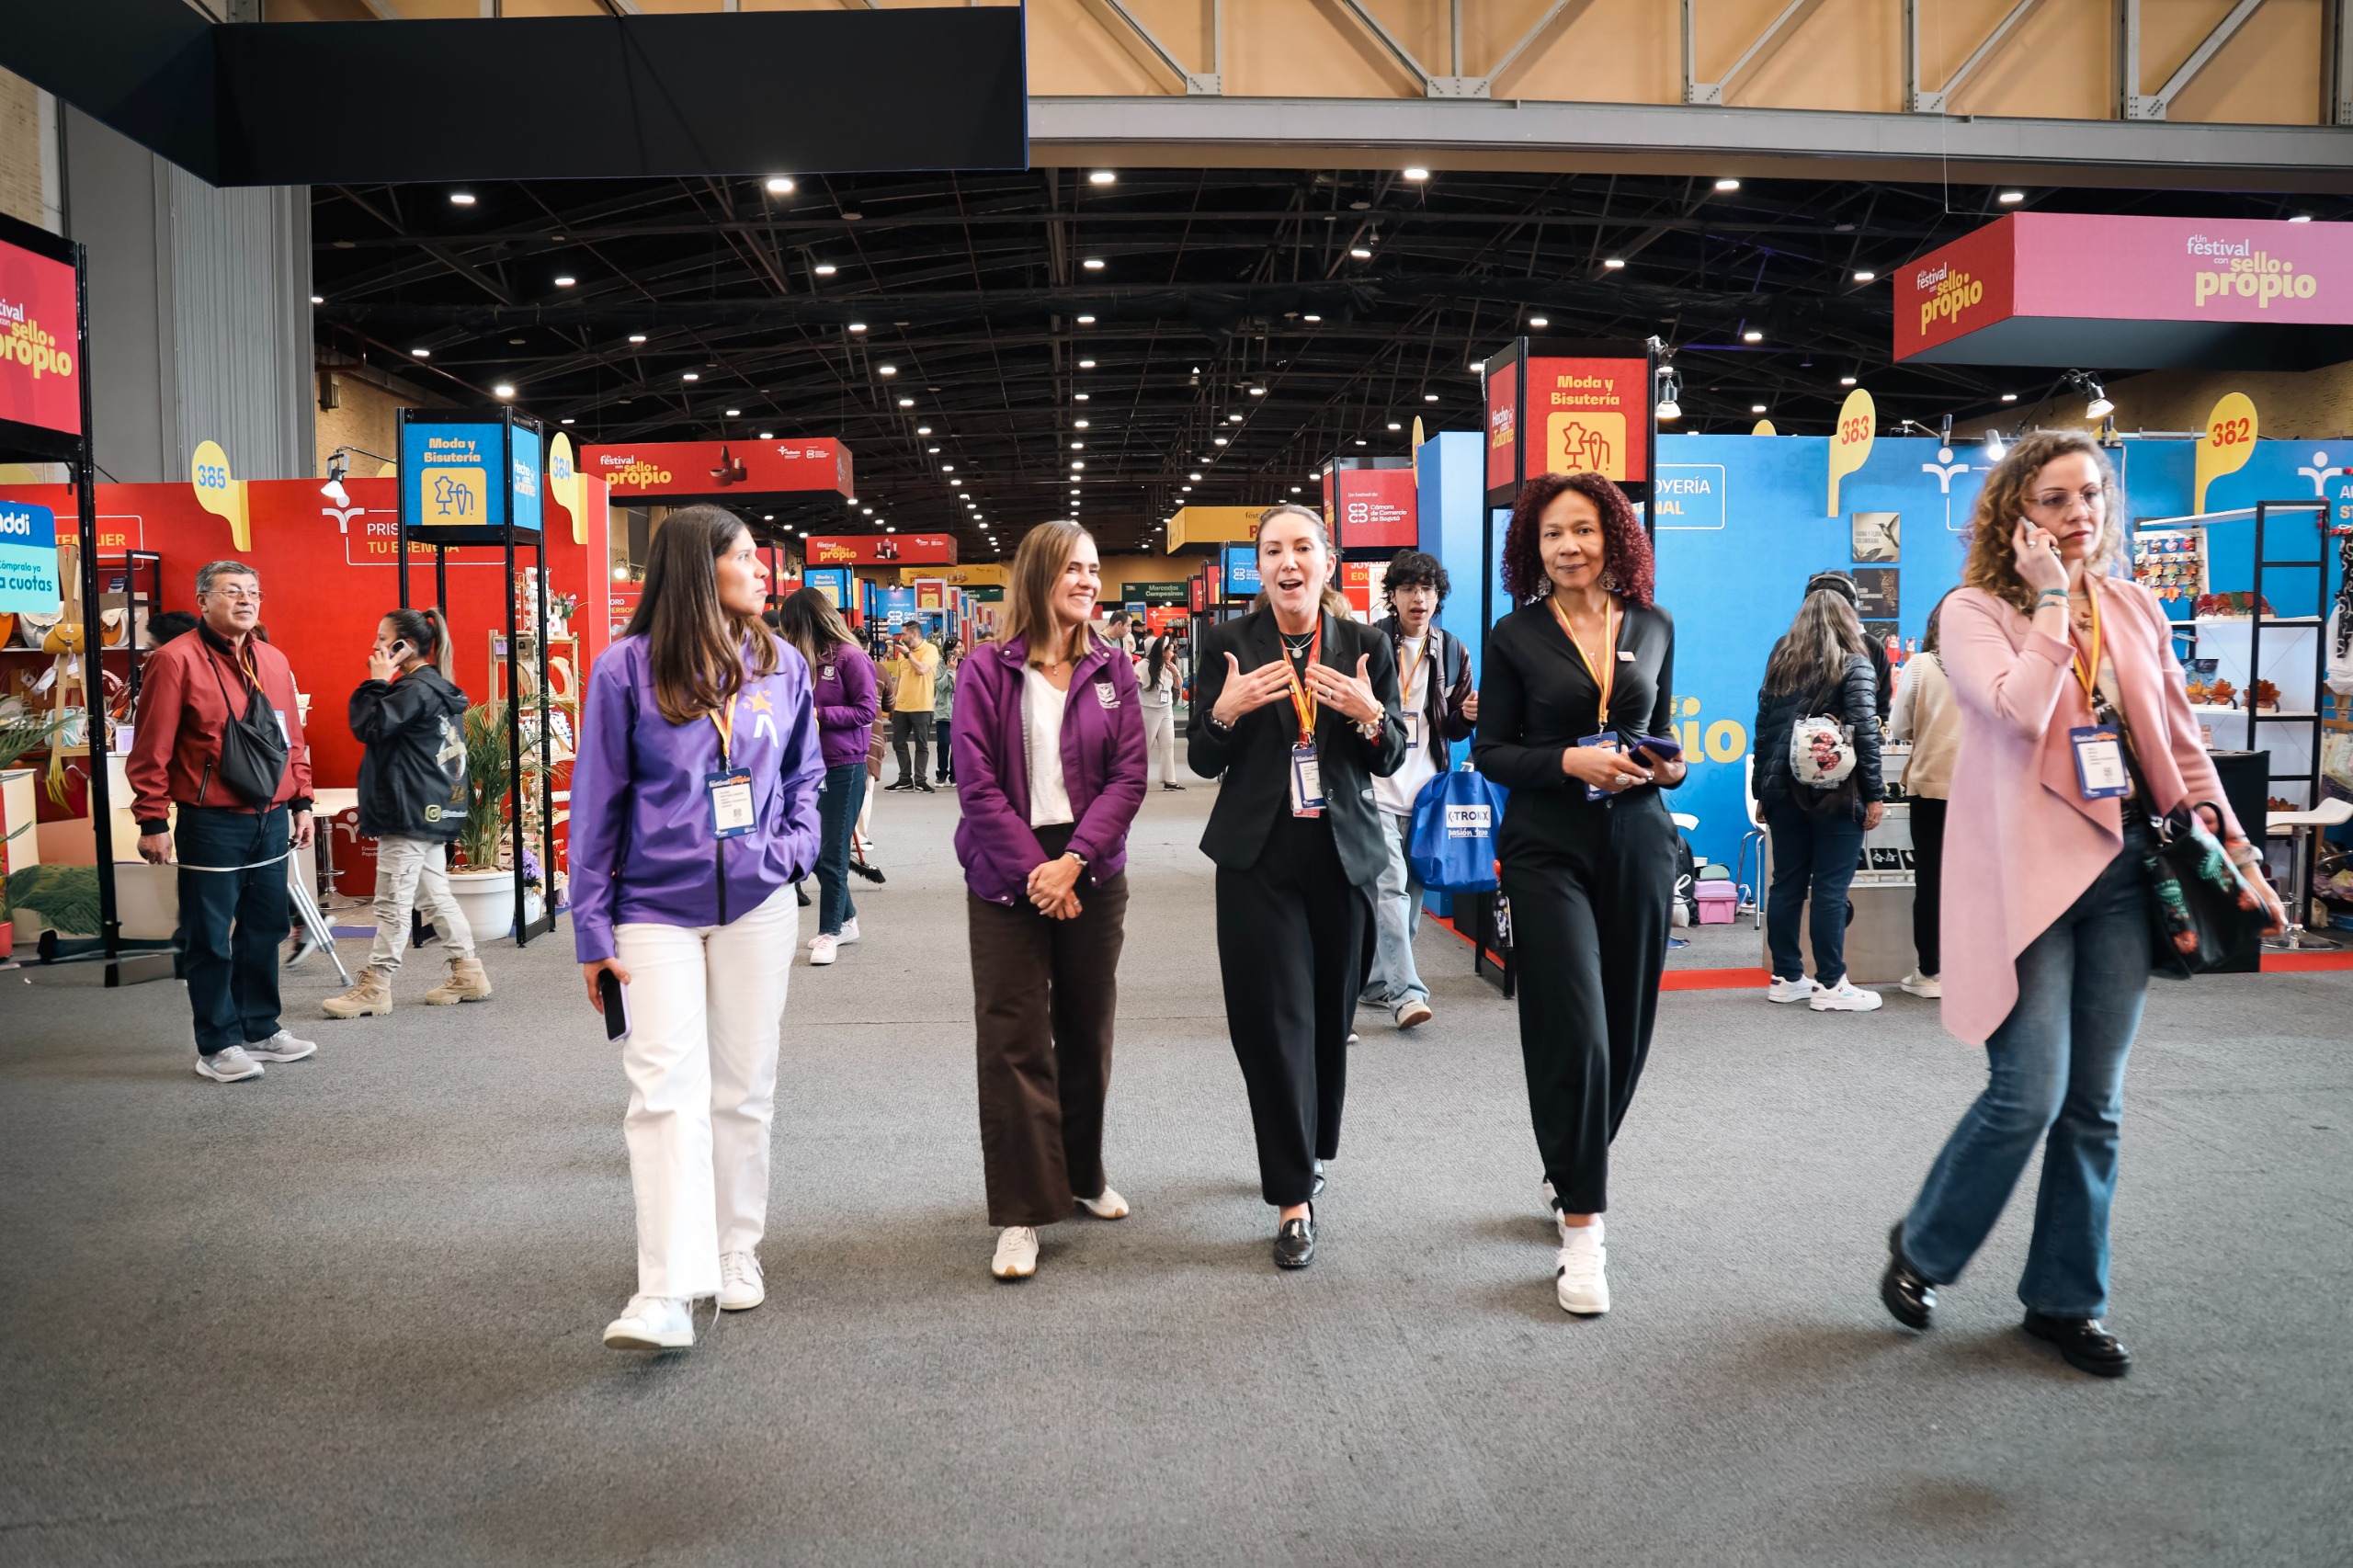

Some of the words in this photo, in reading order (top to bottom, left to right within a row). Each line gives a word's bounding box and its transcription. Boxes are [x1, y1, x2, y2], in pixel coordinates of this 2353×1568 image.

[2187, 236, 2250, 256] festival
[2194, 234, 2207, 243] Un
[2230, 251, 2281, 274] sello
[1916, 261, 1948, 290] festival
[1937, 269, 1963, 297] sello
[2195, 262, 2317, 309] propio
[1921, 273, 1984, 336] propio
[11, 319, 48, 346] sello
[1556, 375, 1602, 389] Moda
[1604, 378, 1614, 392] y
[1551, 390, 1620, 405] Bisutería
[1841, 415, 1870, 446] 383
[2211, 416, 2251, 448] 382
[428, 437, 466, 449] Moda
[468, 440, 476, 451] y
[424, 451, 482, 463] Bisutería
[600, 455, 634, 465] festival
[624, 460, 652, 472] sello
[198, 464, 226, 489] 385
[552, 455, 571, 482] 384
[606, 465, 672, 490] propio
[367, 540, 387, 553] TU
[820, 548, 858, 562] propio
[33, 565, 41, 574] ya
[9, 574, 52, 592] cuotas
